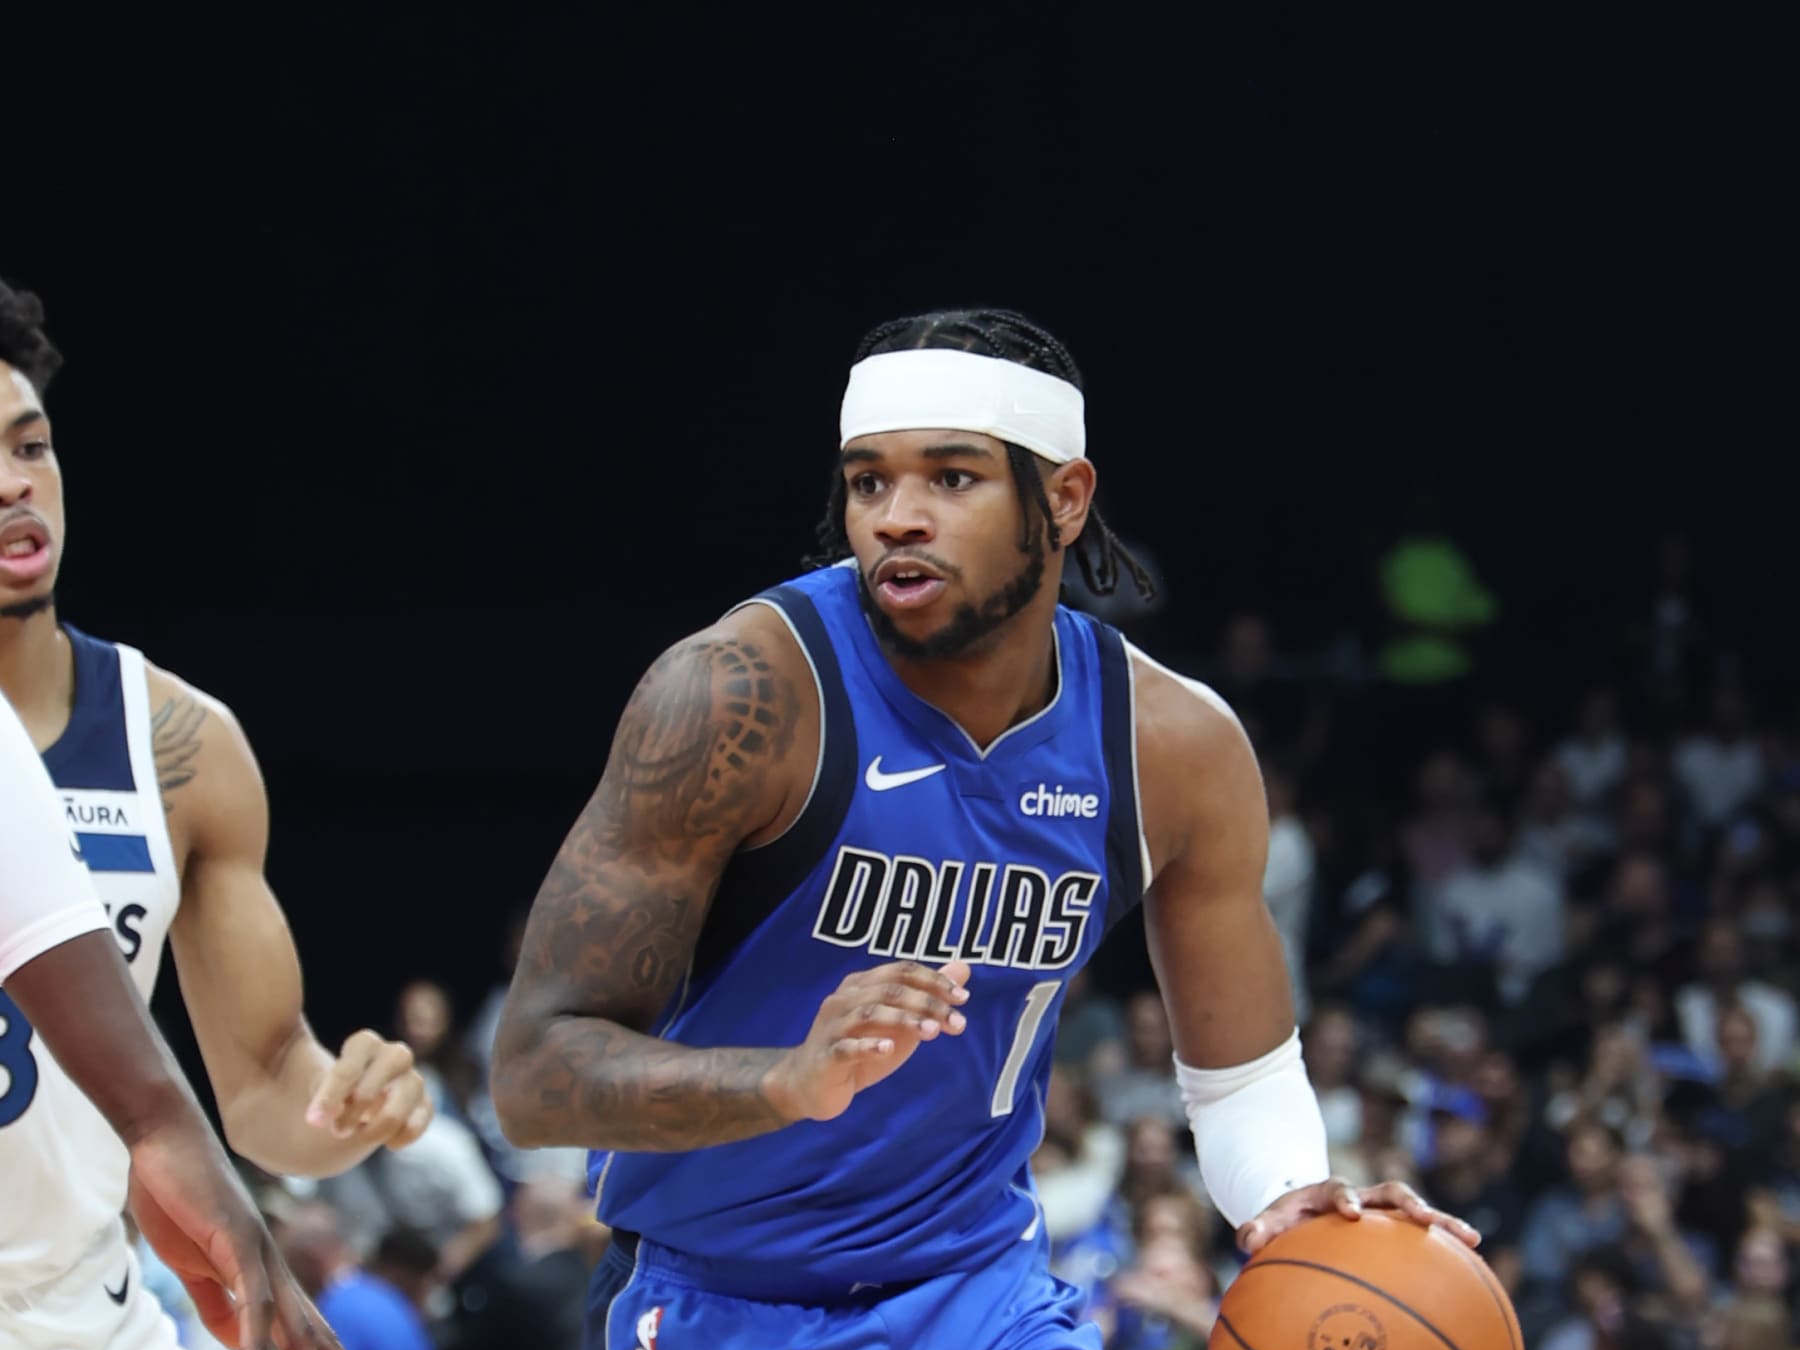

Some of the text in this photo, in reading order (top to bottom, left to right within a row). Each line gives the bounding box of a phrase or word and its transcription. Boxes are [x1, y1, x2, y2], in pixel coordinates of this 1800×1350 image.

[1019, 783, 1100, 819] chime
[812, 845, 1102, 971] DALLAS
[990, 980, 1063, 1118] 1
